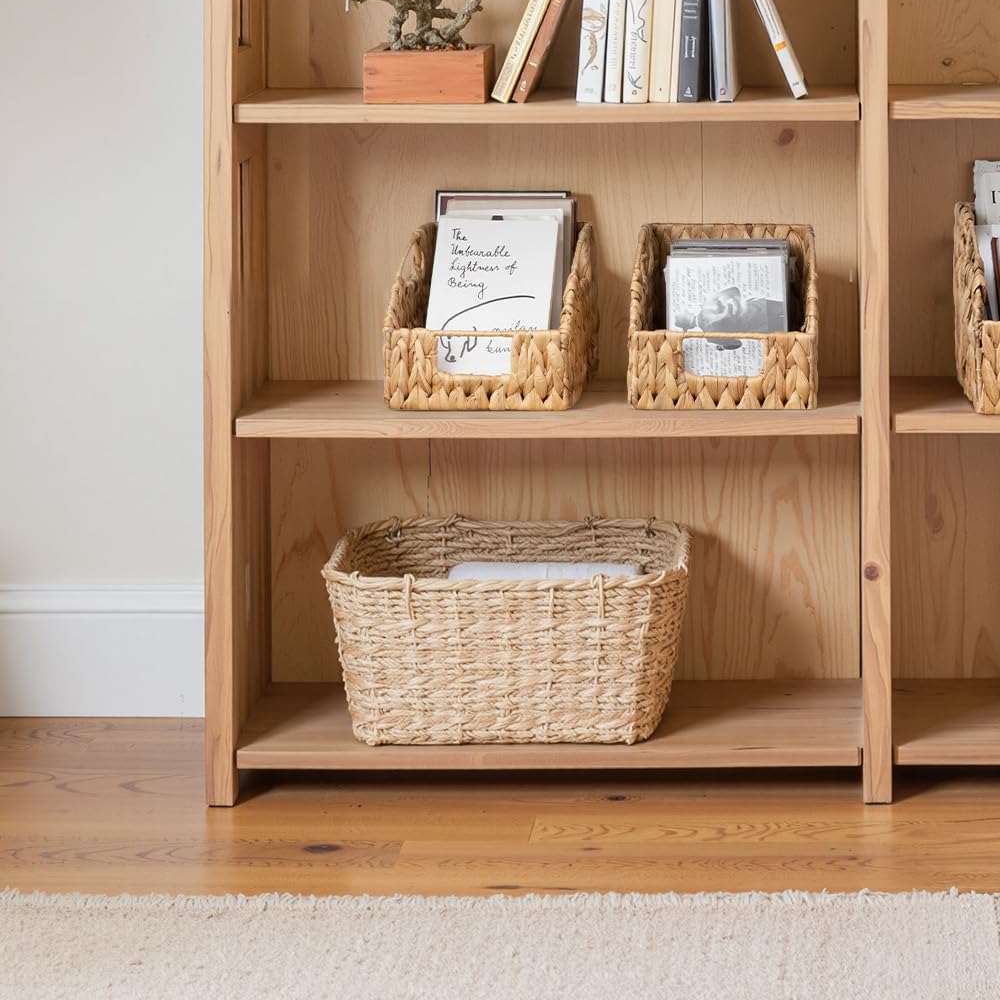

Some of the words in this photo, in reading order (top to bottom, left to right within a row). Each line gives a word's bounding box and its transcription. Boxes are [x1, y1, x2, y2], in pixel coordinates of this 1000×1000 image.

[452, 228, 467, 242] The
[450, 243, 511, 257] Unbearable
[449, 258, 500, 278] Lightness
[505, 261, 518, 276] of
[448, 278, 488, 299] Being
